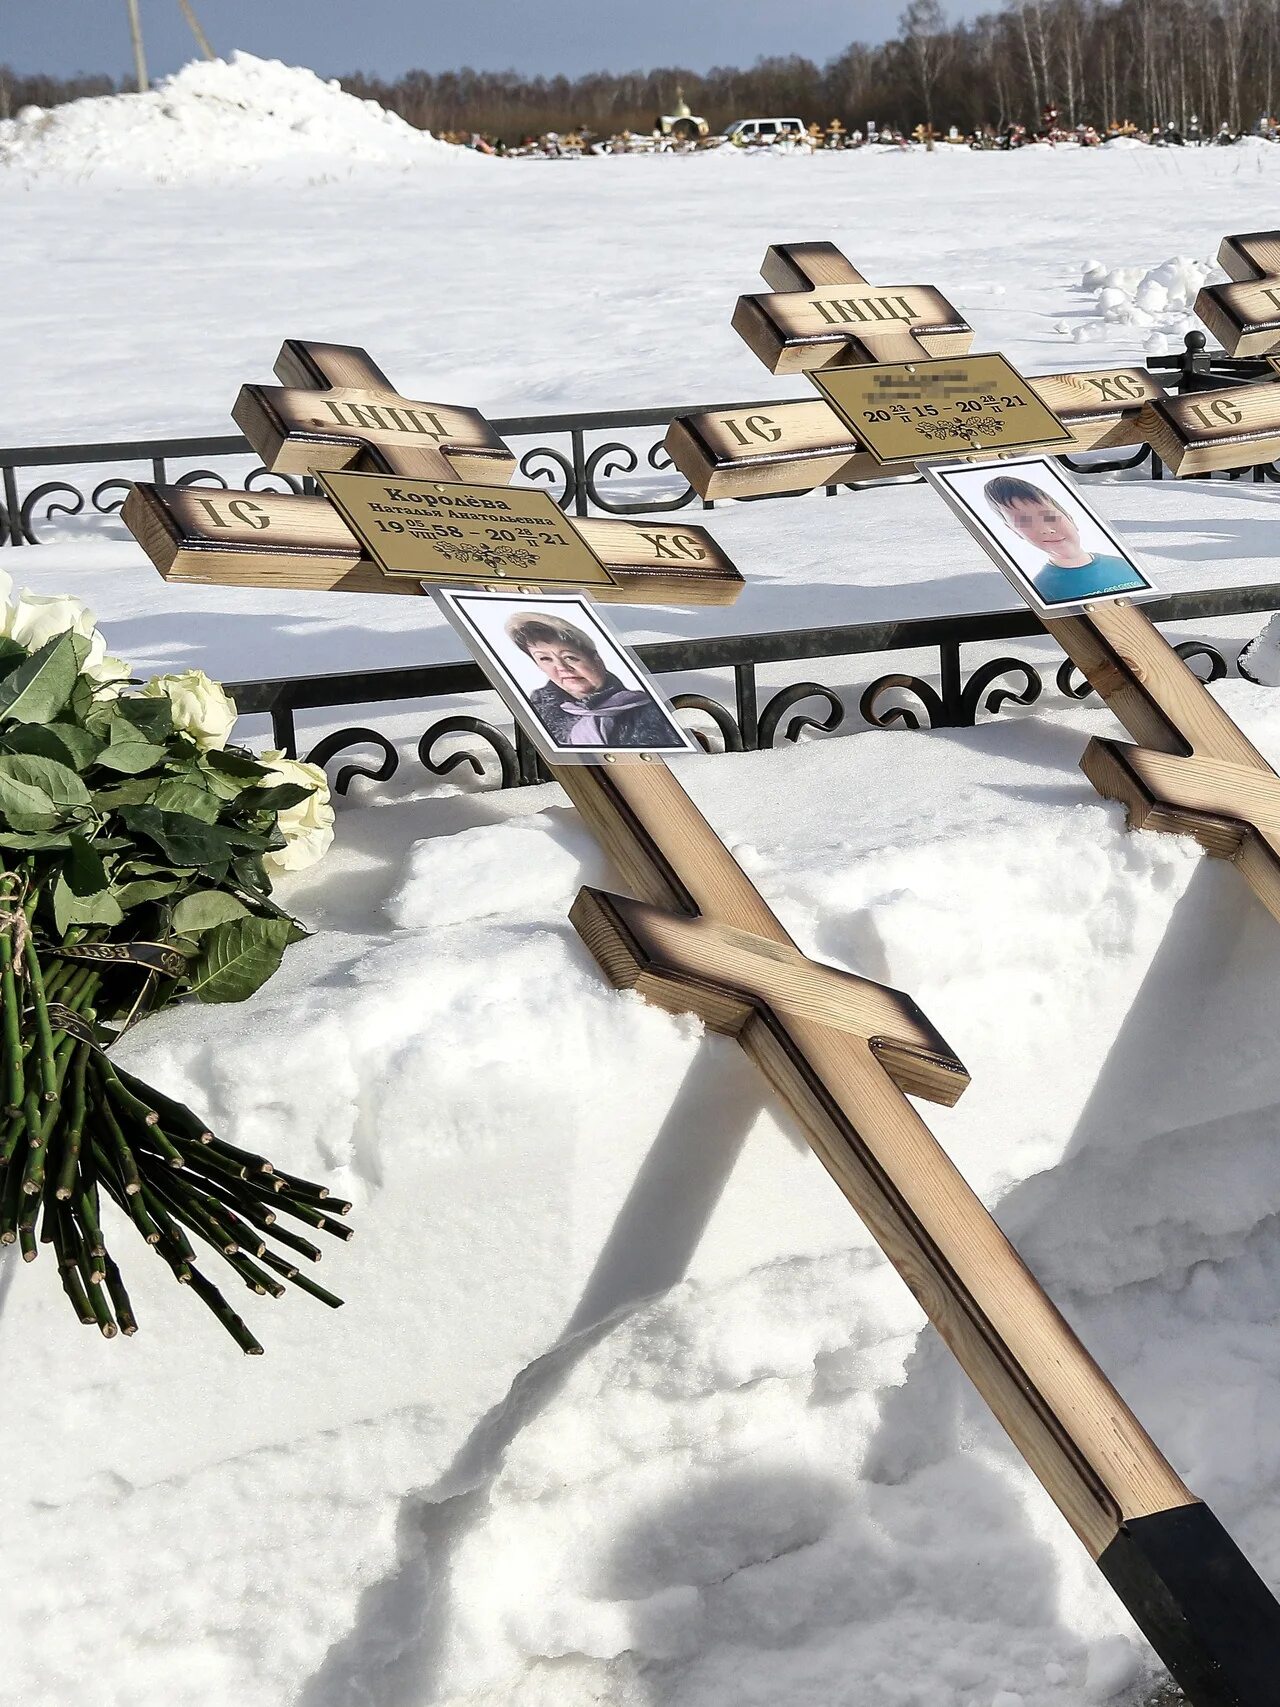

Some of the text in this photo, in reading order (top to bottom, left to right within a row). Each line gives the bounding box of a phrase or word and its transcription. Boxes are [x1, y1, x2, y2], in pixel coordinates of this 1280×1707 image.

[383, 487, 511, 511] Королёва
[368, 502, 556, 526] Наталья Анатольевна
